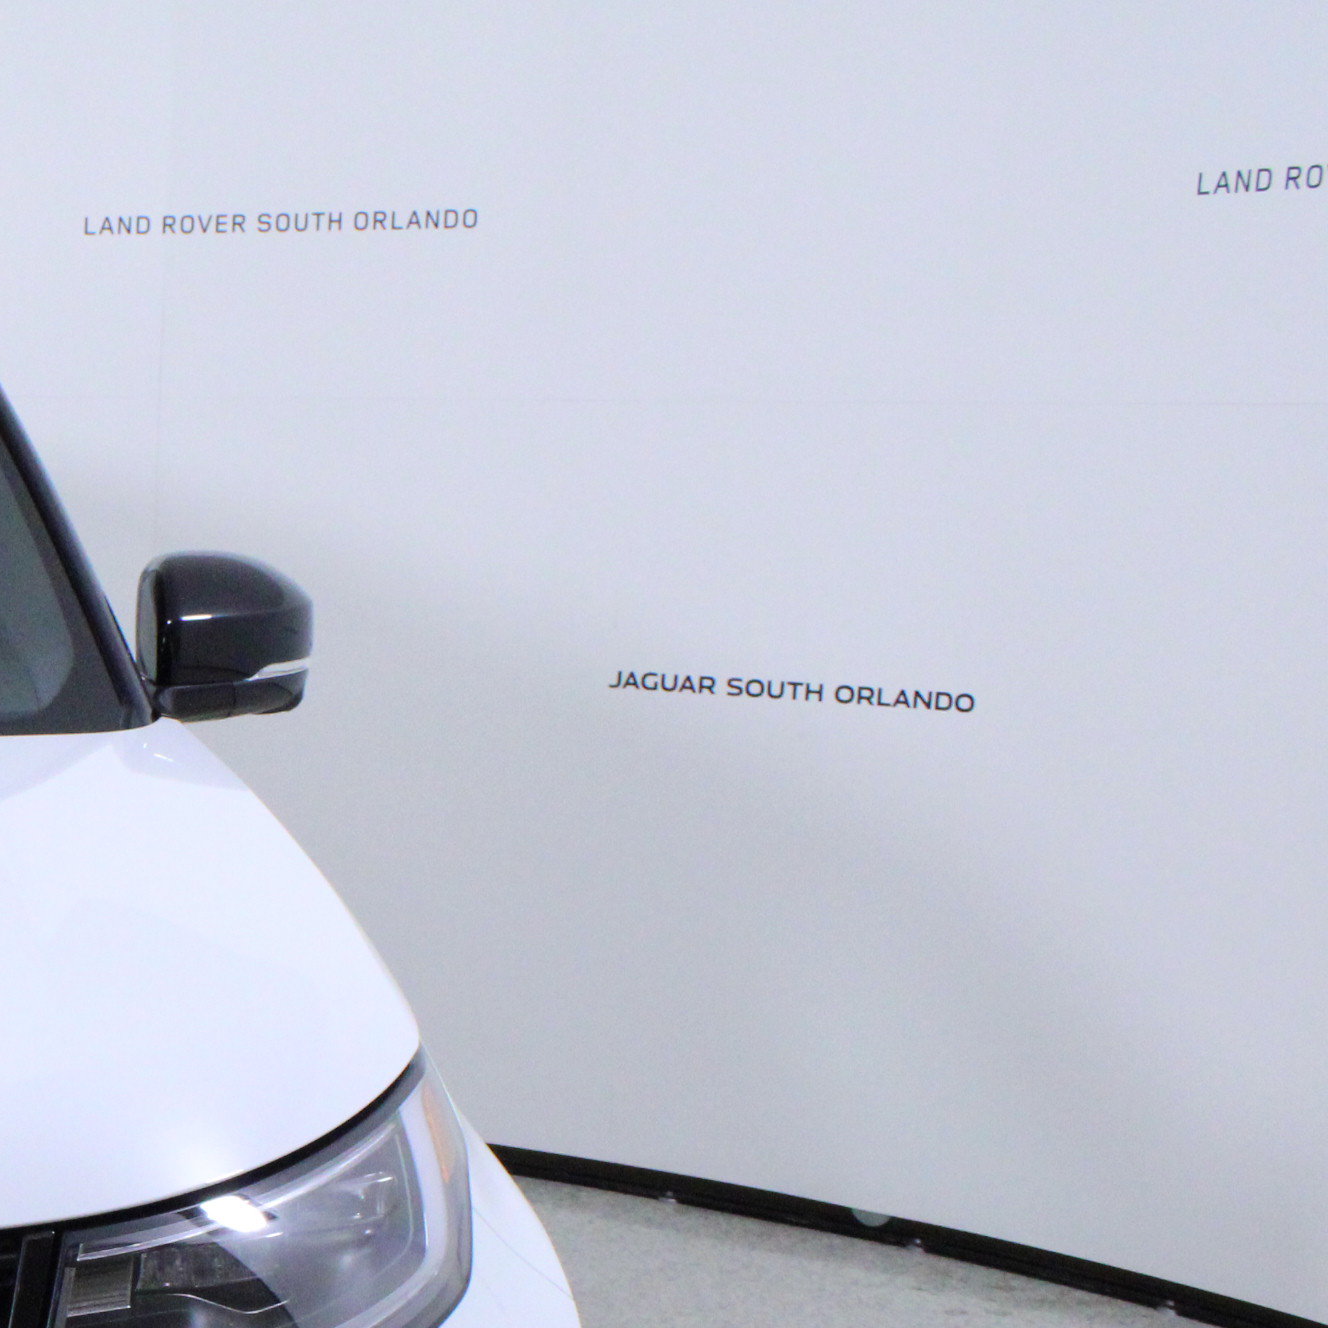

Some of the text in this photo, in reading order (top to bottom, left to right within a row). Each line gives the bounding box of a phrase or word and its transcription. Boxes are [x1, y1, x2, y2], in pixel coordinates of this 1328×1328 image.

[1196, 162, 1328, 197] LAND RO
[83, 207, 479, 237] LAND ROVER SOUTH ORLANDO
[607, 669, 977, 715] JAGUAR SOUTH ORLANDO
